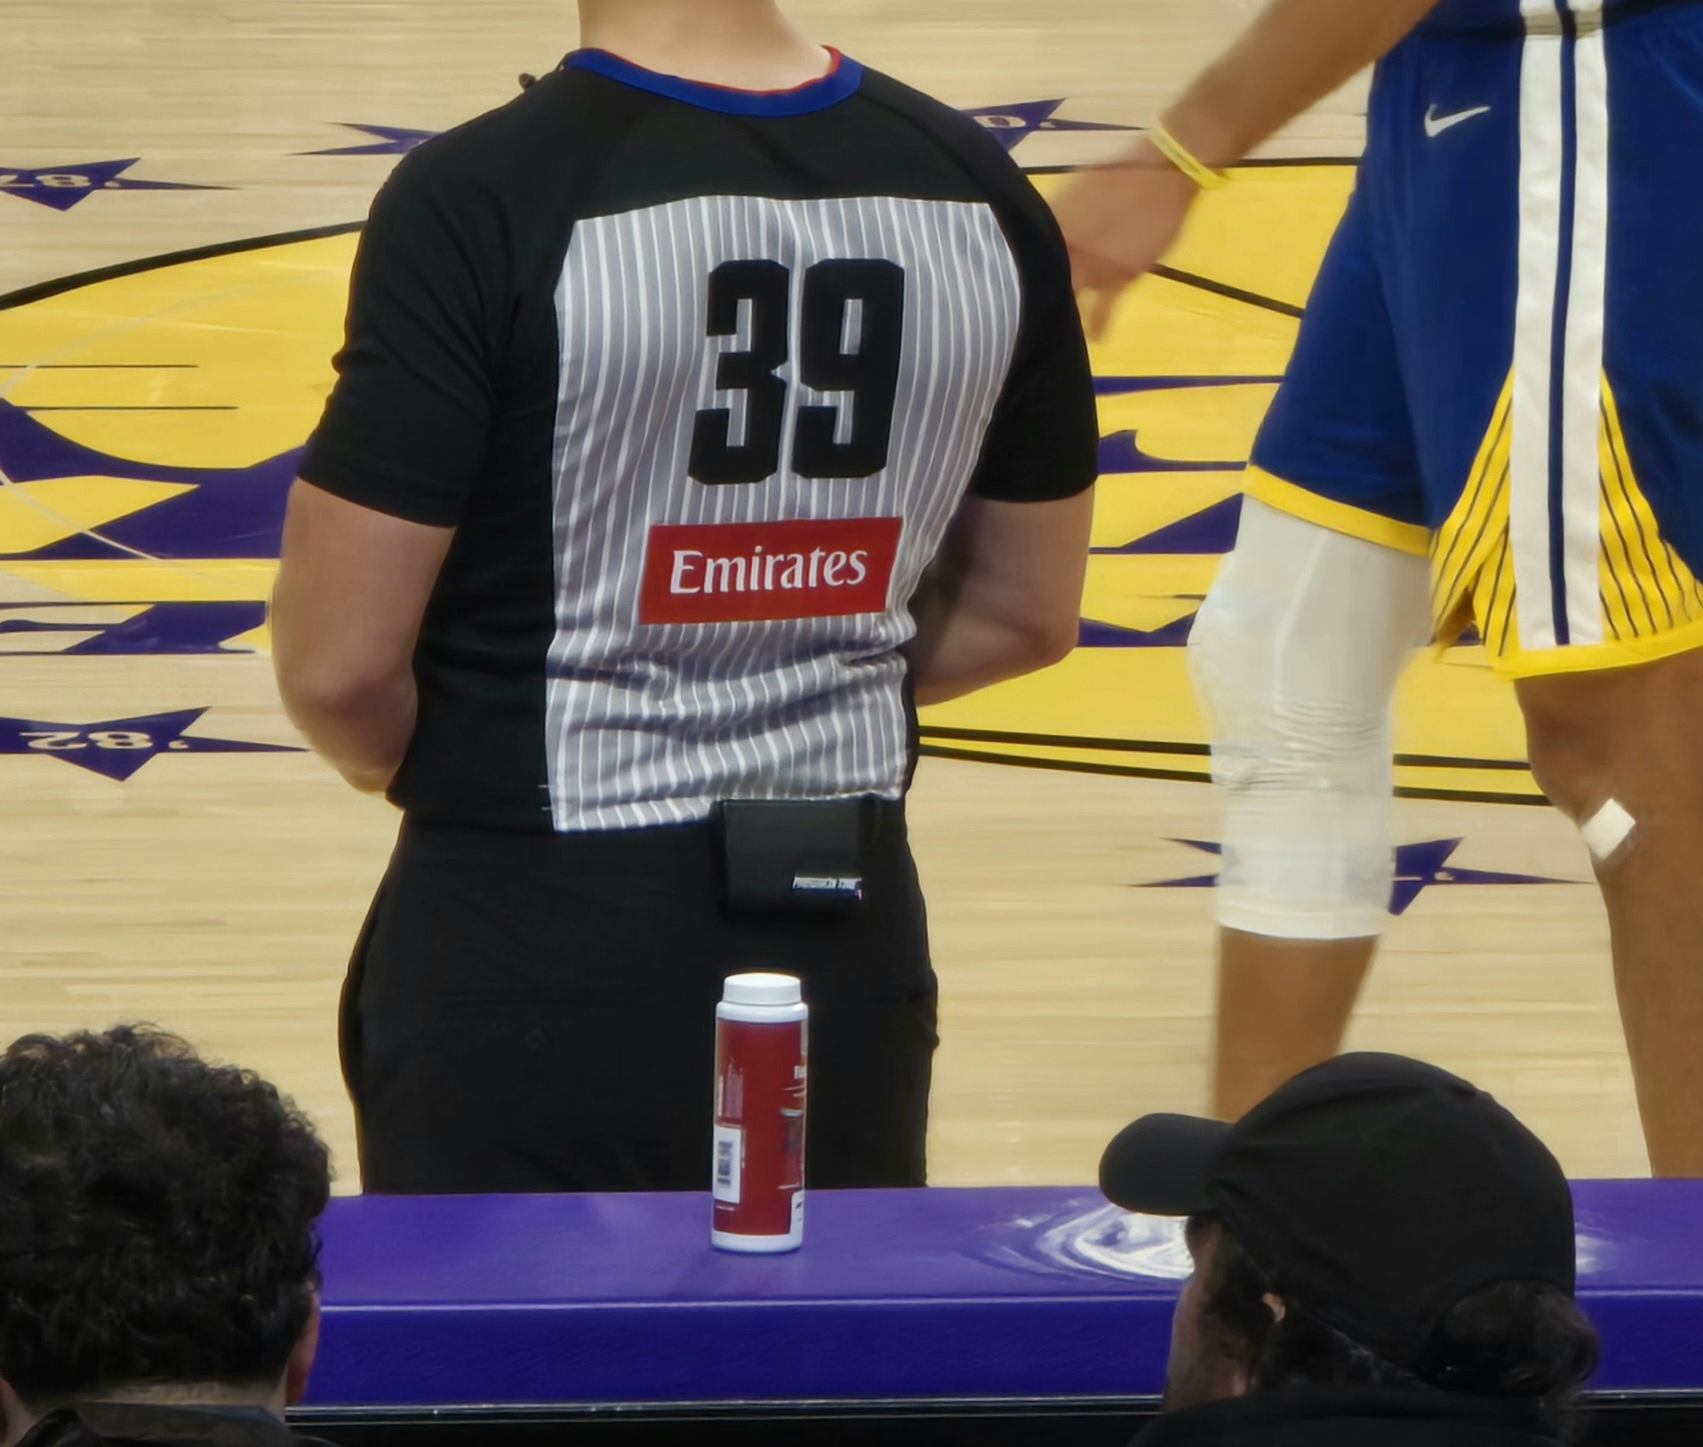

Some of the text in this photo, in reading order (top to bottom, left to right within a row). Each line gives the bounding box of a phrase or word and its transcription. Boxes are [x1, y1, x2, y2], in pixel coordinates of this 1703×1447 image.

[687, 257, 906, 485] 39
[669, 543, 869, 596] Emirates
[17, 727, 190, 753] '82
